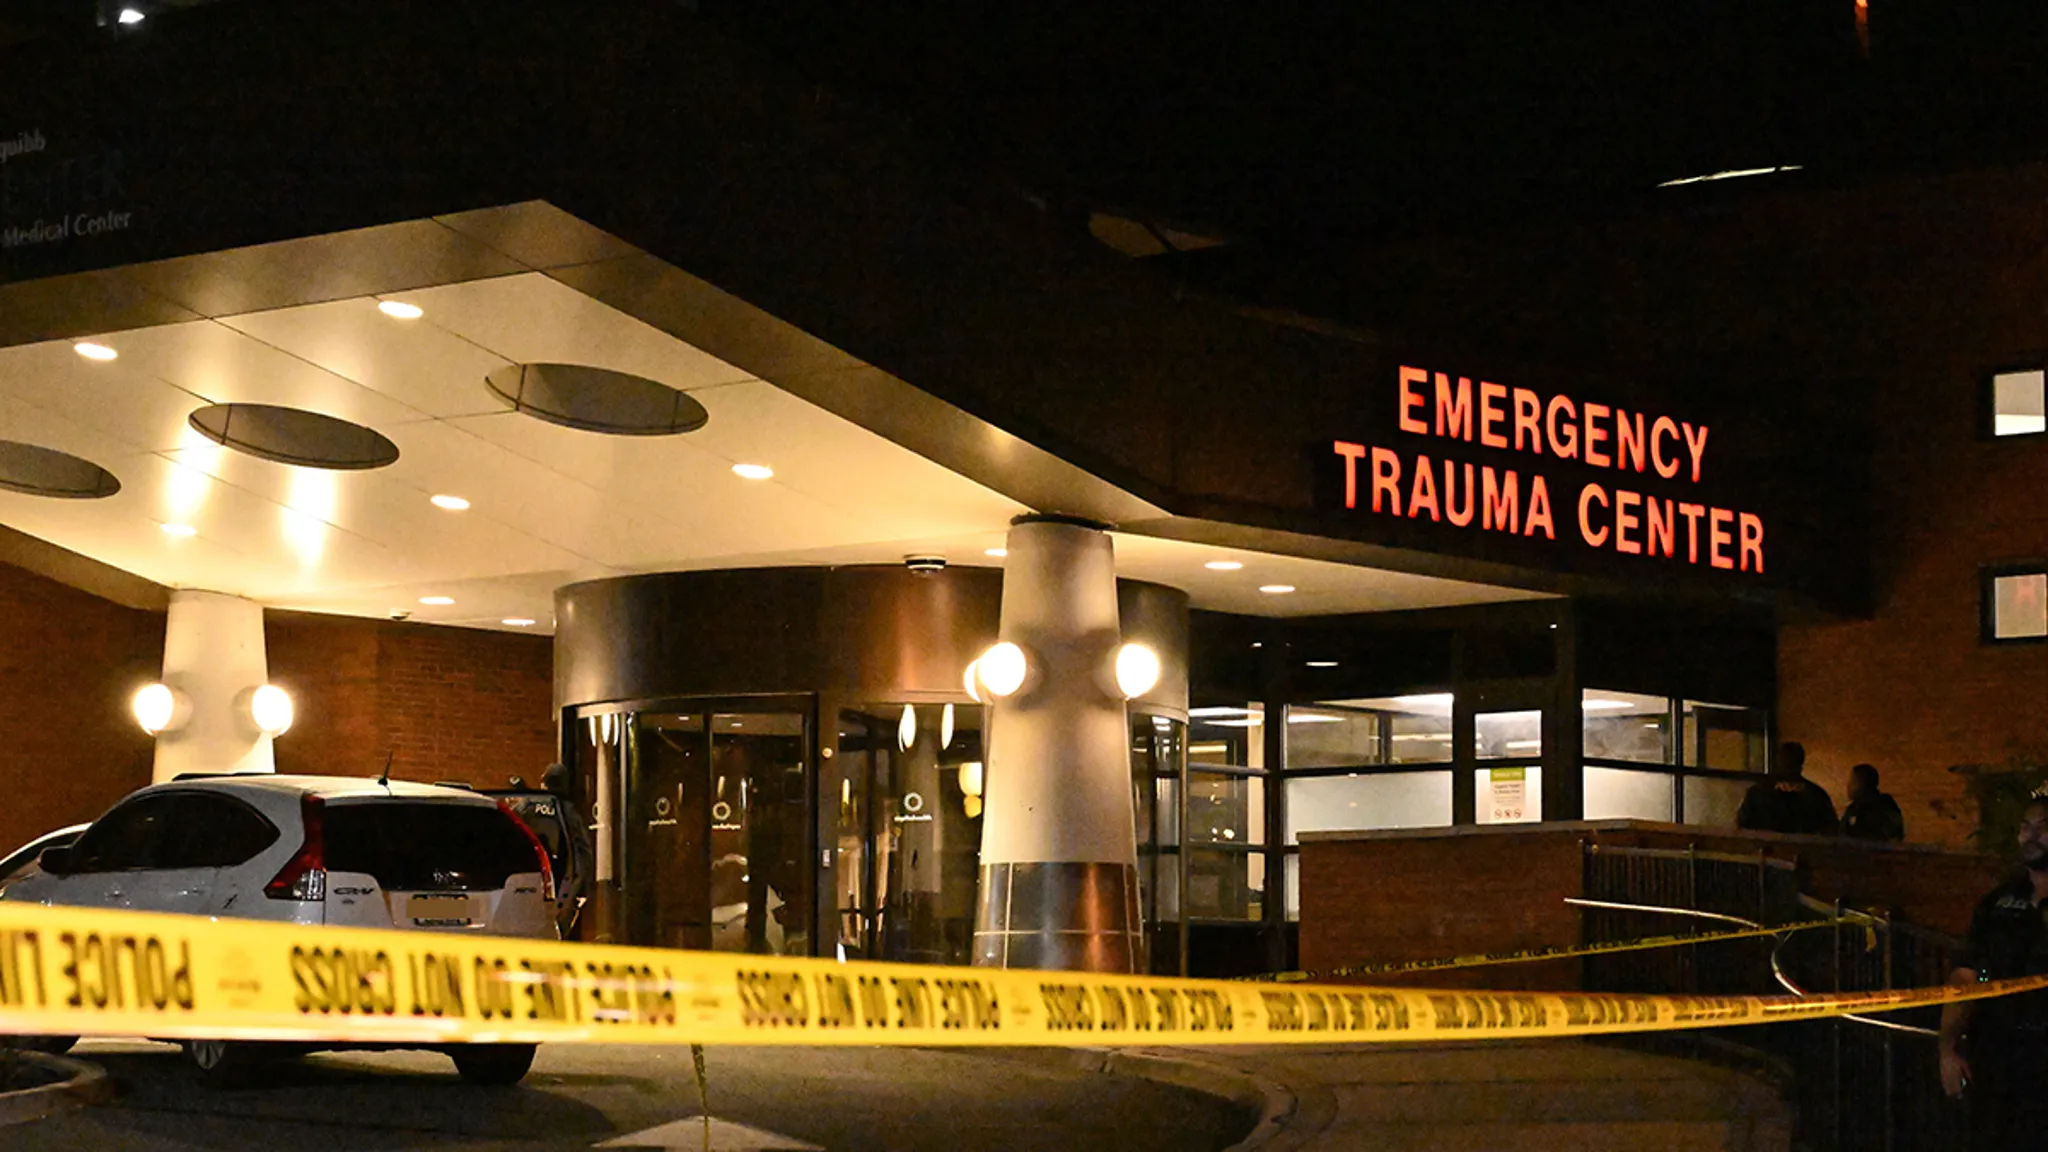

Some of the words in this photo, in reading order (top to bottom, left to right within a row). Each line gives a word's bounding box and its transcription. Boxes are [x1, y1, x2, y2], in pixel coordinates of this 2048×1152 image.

[3, 214, 69, 247] Medical
[74, 210, 132, 236] Center
[1399, 365, 1708, 483] EMERGENCY
[1334, 440, 1555, 541] TRAUMA
[1578, 483, 1764, 574] CENTER
[57, 933, 195, 1011] POLICE
